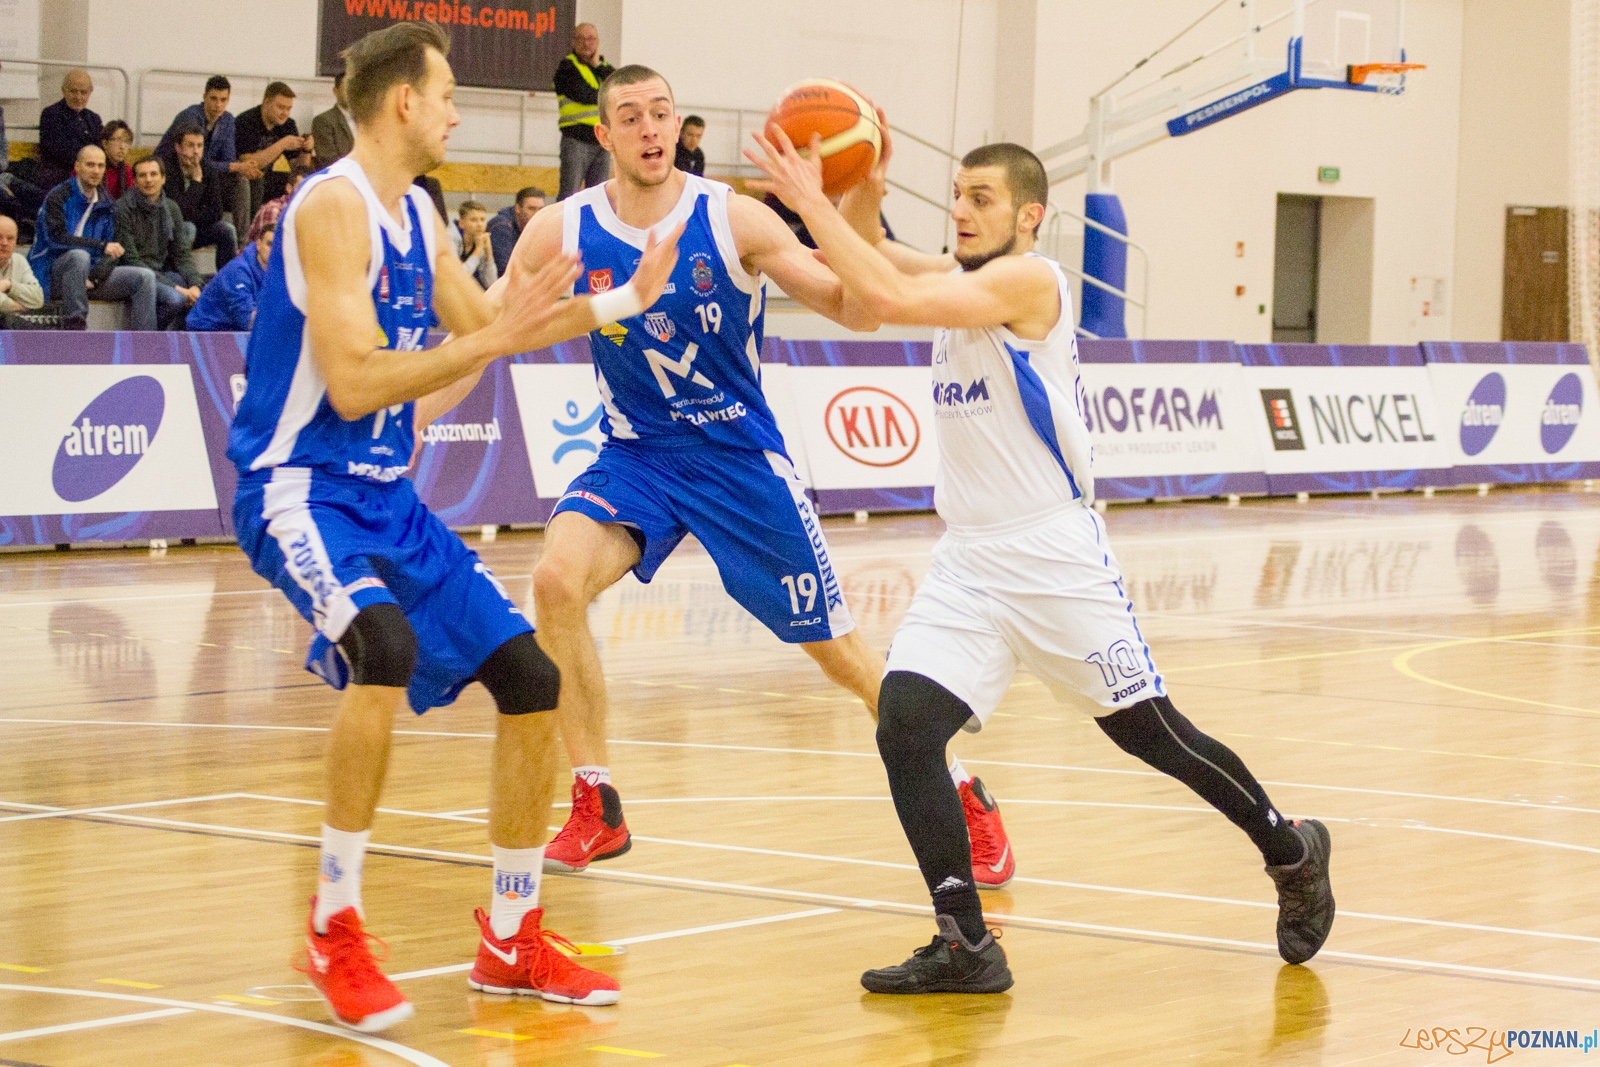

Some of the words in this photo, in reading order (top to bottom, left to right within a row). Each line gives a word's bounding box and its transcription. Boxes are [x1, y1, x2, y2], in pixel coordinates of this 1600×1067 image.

[344, 0, 556, 38] www.rebis.com.pl
[1186, 84, 1272, 126] PESMENPOL
[694, 302, 722, 334] 19
[669, 401, 747, 426] MRAWIEC
[838, 406, 908, 448] KIA
[1308, 394, 1436, 444] NICKEL
[1462, 398, 1503, 426] atrem
[1542, 398, 1581, 426] atrem
[64, 417, 148, 457] atrem
[797, 501, 843, 613] PRUDNIK
[780, 572, 818, 615] 19
[790, 616, 822, 627] COLO
[1085, 639, 1144, 687] 10
